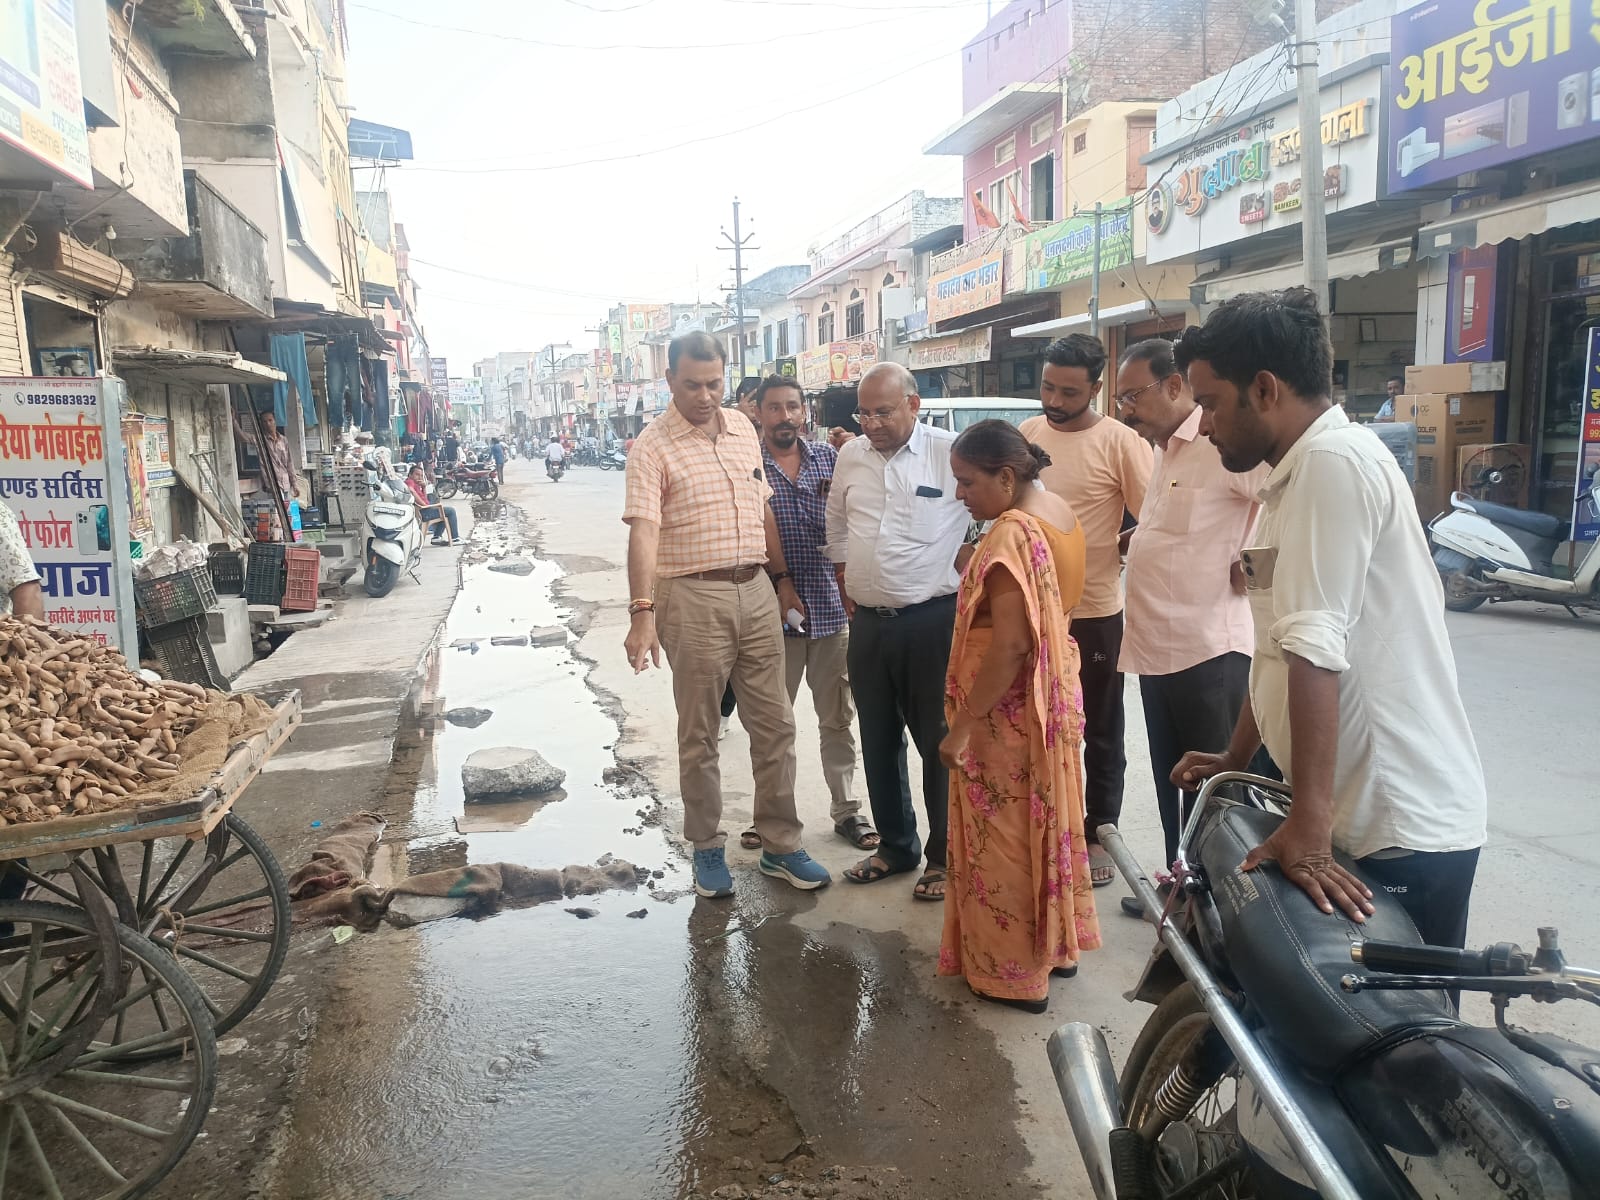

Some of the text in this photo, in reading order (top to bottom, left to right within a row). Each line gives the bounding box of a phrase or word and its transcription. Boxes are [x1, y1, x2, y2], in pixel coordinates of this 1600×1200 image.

[1324, 187, 1338, 197] ERY
[1274, 199, 1299, 212] NAMKEEN
[1240, 211, 1264, 223] SWEETS
[27, 394, 97, 406] 9829683832
[32, 410, 103, 466] मोबाईल
[41, 469, 104, 499] सर्विस
[33, 509, 74, 549] फोन
[77, 605, 102, 624] अपने
[103, 609, 116, 623] घर
